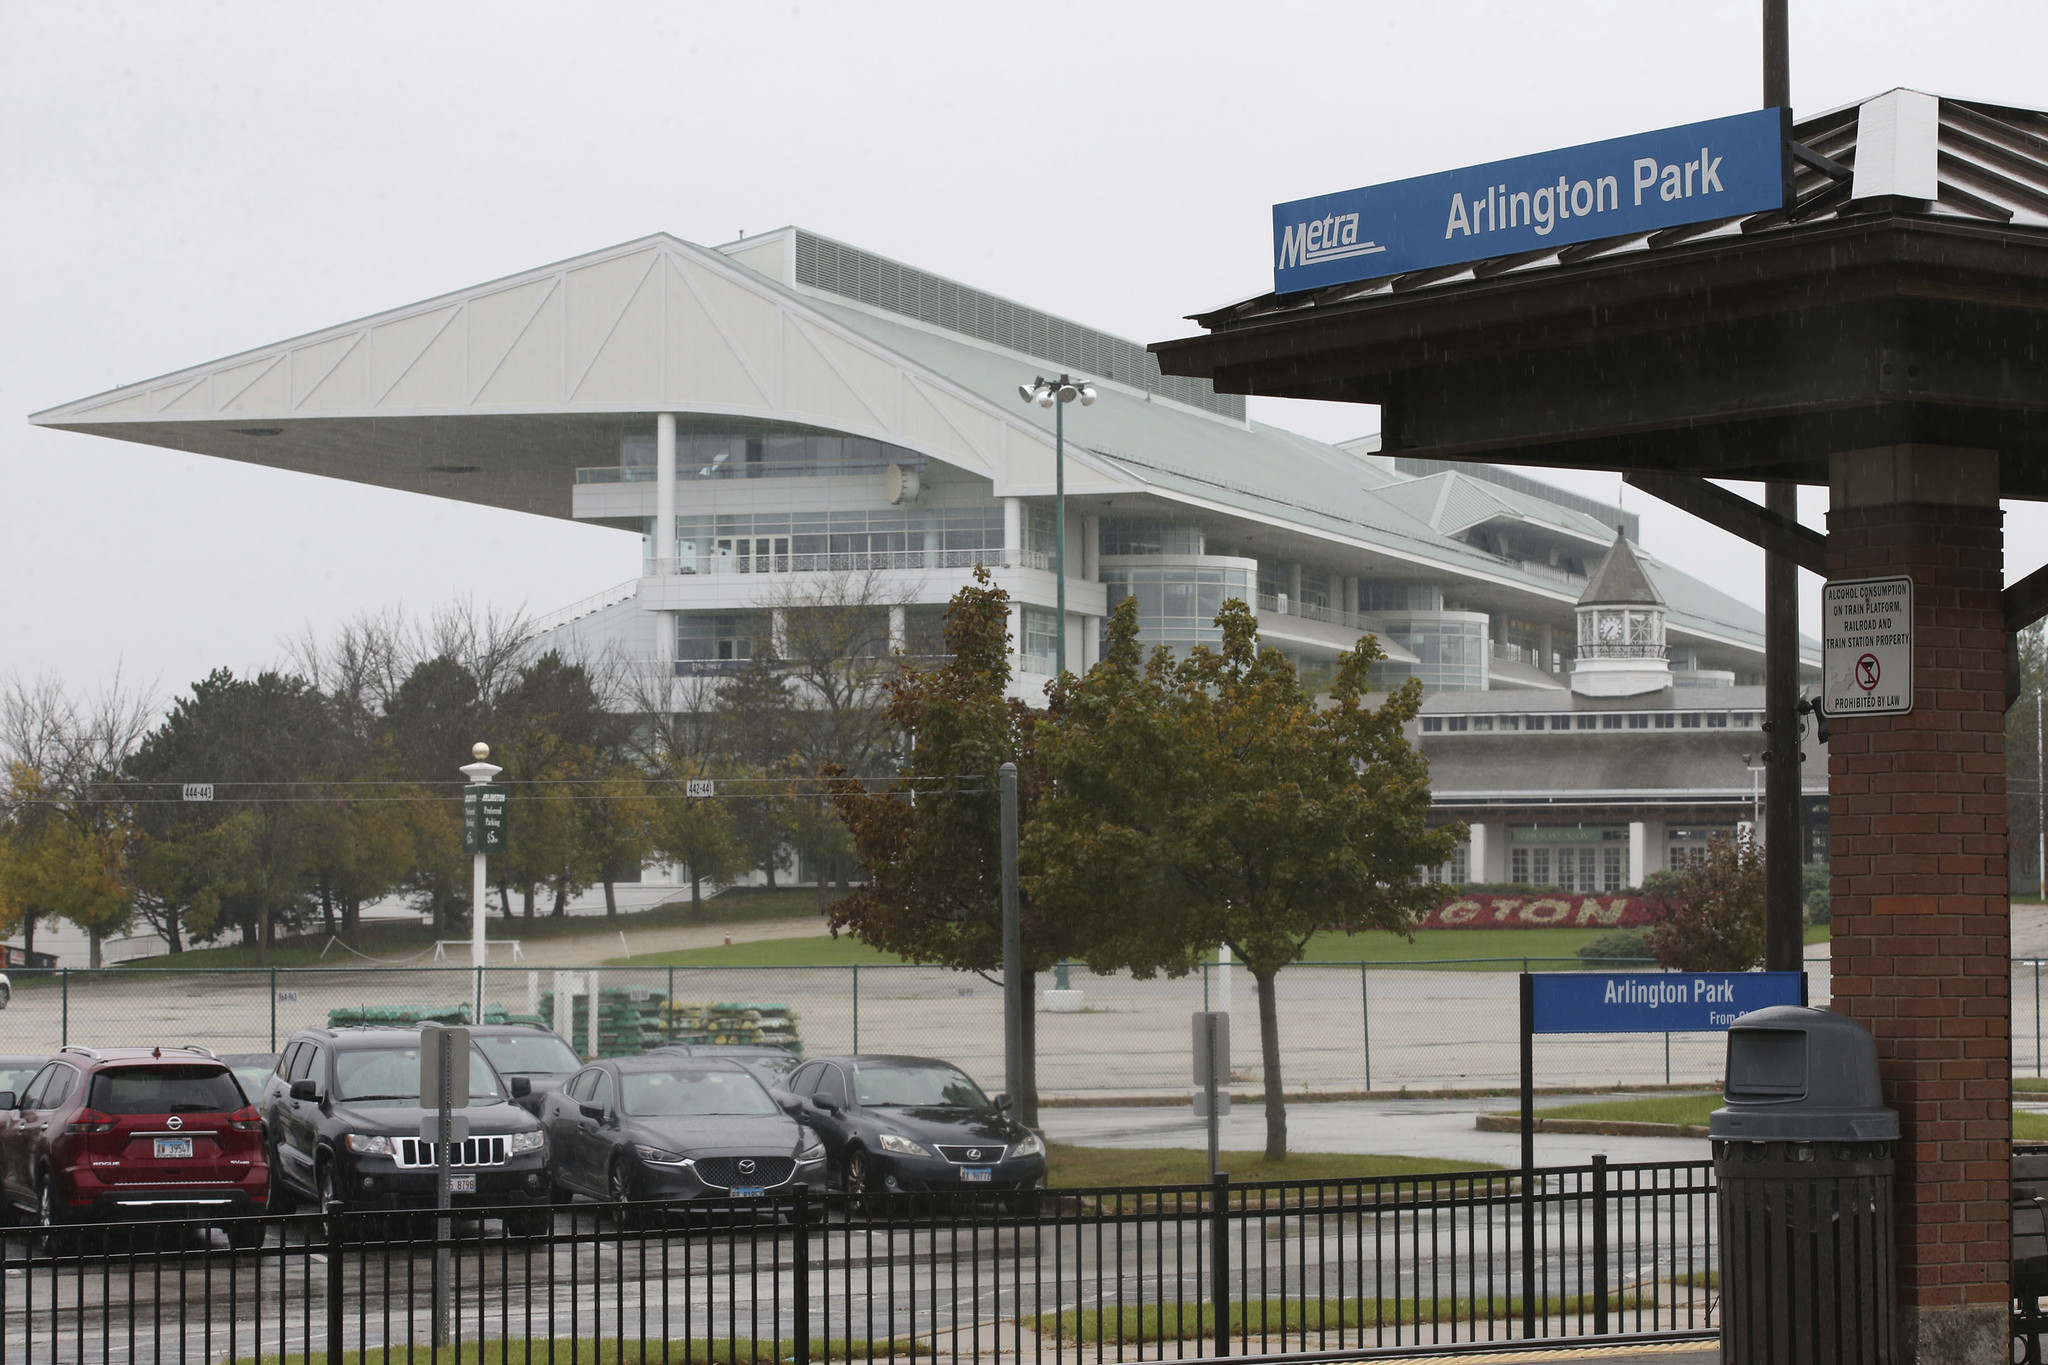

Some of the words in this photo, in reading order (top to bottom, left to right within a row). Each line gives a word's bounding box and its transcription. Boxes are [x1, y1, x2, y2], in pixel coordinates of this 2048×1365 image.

[1279, 211, 1374, 270] Metra
[1445, 174, 1619, 239] Arlington
[1633, 146, 1724, 207] Park
[1828, 587, 1858, 600] ALCOHOL
[1859, 583, 1907, 598] CONSUMPTION
[1833, 605, 1843, 616] ON
[1844, 604, 1864, 616] TRAIN
[1866, 601, 1902, 614] PLATFORM,
[1844, 619, 1877, 632] RAILROAD
[1878, 618, 1892, 630] AND
[1826, 637, 1847, 650] TRAIN
[1847, 635, 1874, 649] STATION
[1875, 634, 1910, 647] PROPERTY
[1835, 696, 1876, 709] PROHIBITED
[1877, 696, 1886, 707] BY
[1887, 695, 1901, 707] LAW
[185, 786, 212, 799] 444-443
[689, 783, 712, 795] 442-441
[485, 817, 501, 828] Parking
[1604, 980, 1688, 1009] Arlington
[1694, 979, 1734, 1003] Park
[1710, 1012, 1735, 1025] From
[457, 1179, 475, 1190] 8798
